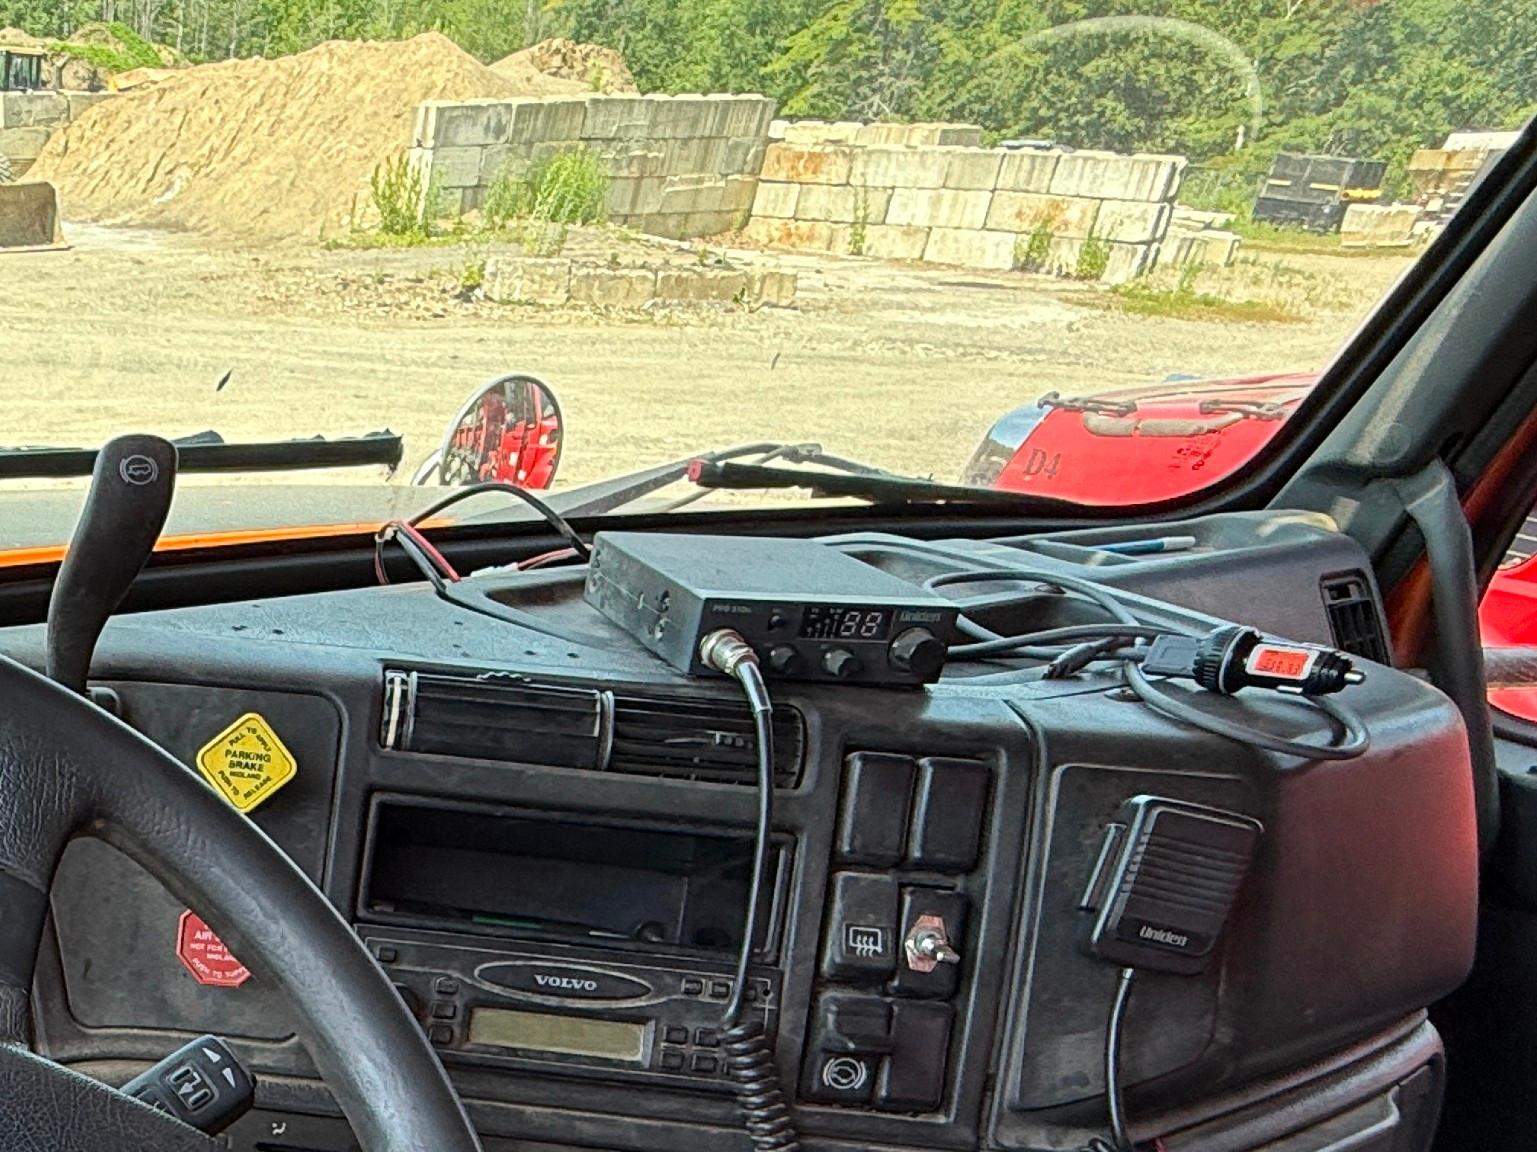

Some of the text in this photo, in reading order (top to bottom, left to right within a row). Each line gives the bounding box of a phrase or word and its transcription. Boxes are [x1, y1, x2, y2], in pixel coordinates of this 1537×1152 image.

[225, 749, 271, 763] PARKING
[228, 760, 265, 772] BRAKE
[1139, 925, 1188, 947] Uniden
[533, 974, 598, 992] VOLVO
